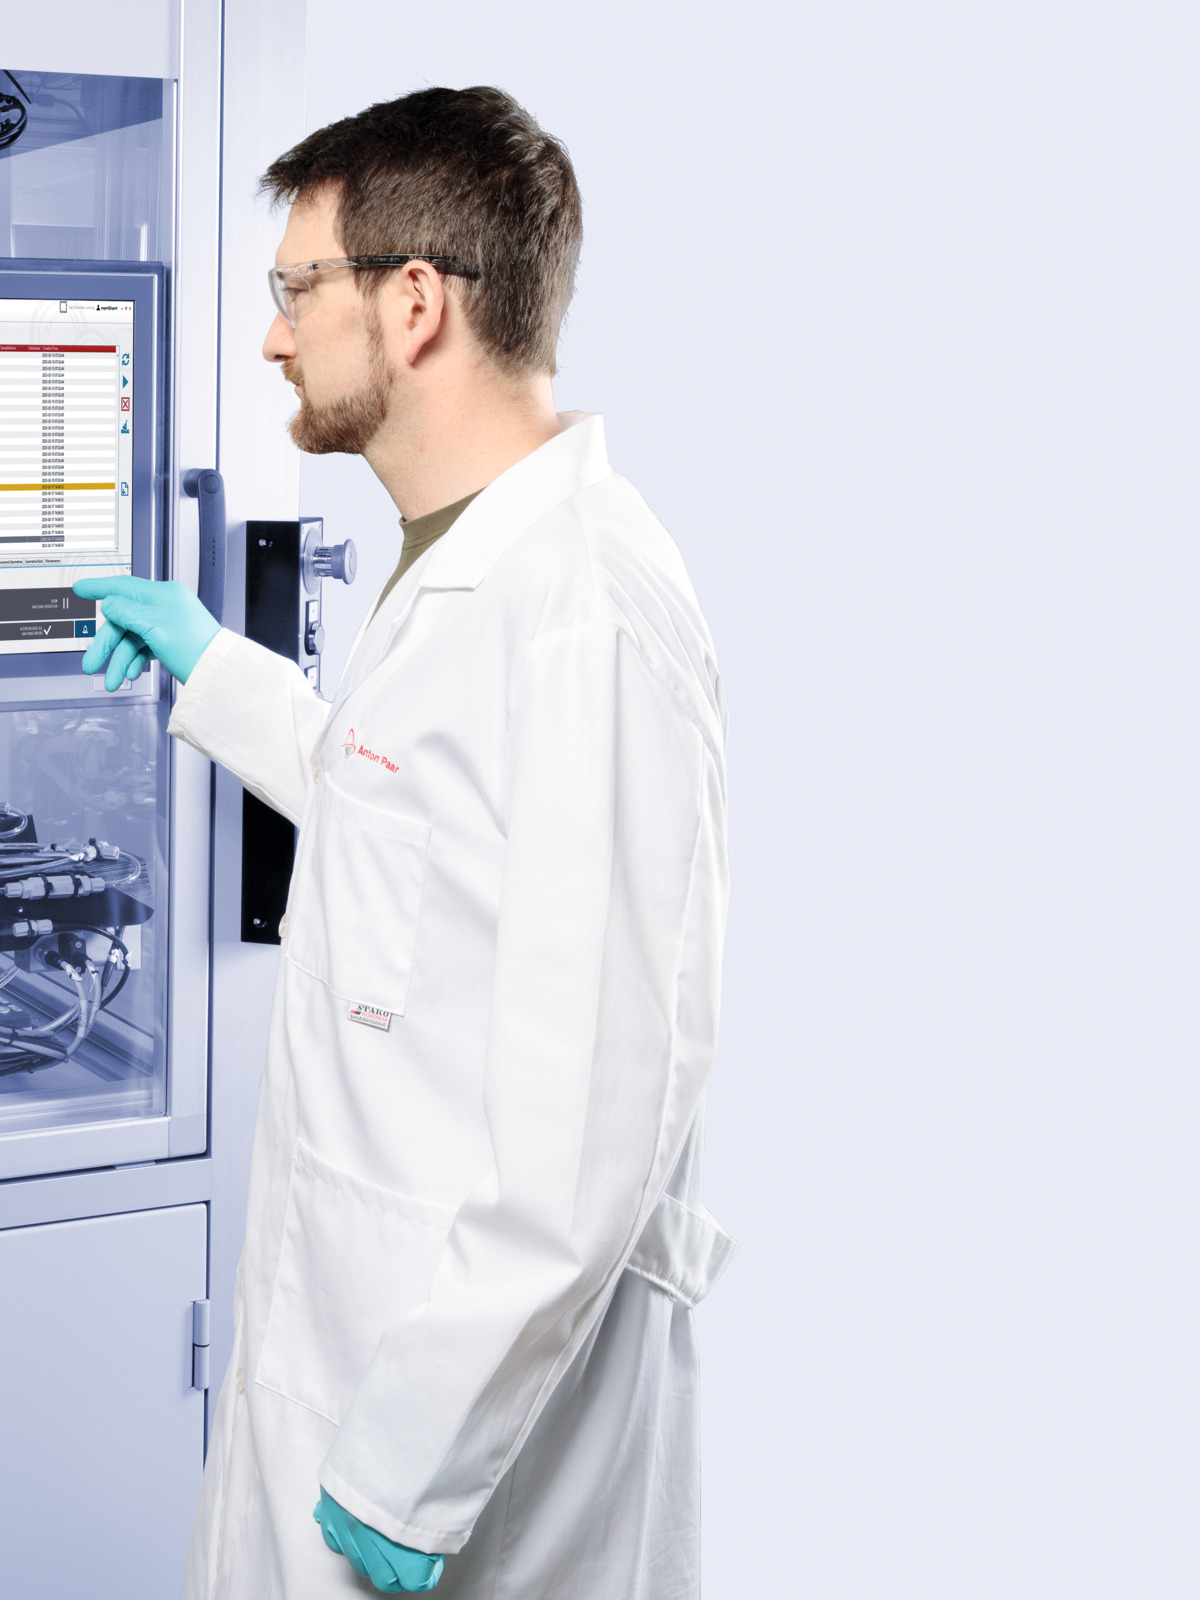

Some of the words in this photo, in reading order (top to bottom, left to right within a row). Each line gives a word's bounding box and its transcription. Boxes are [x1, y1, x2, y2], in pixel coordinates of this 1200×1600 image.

[358, 745, 380, 763] Anton
[380, 756, 399, 773] Paar
[357, 1004, 389, 1017] STAKO
